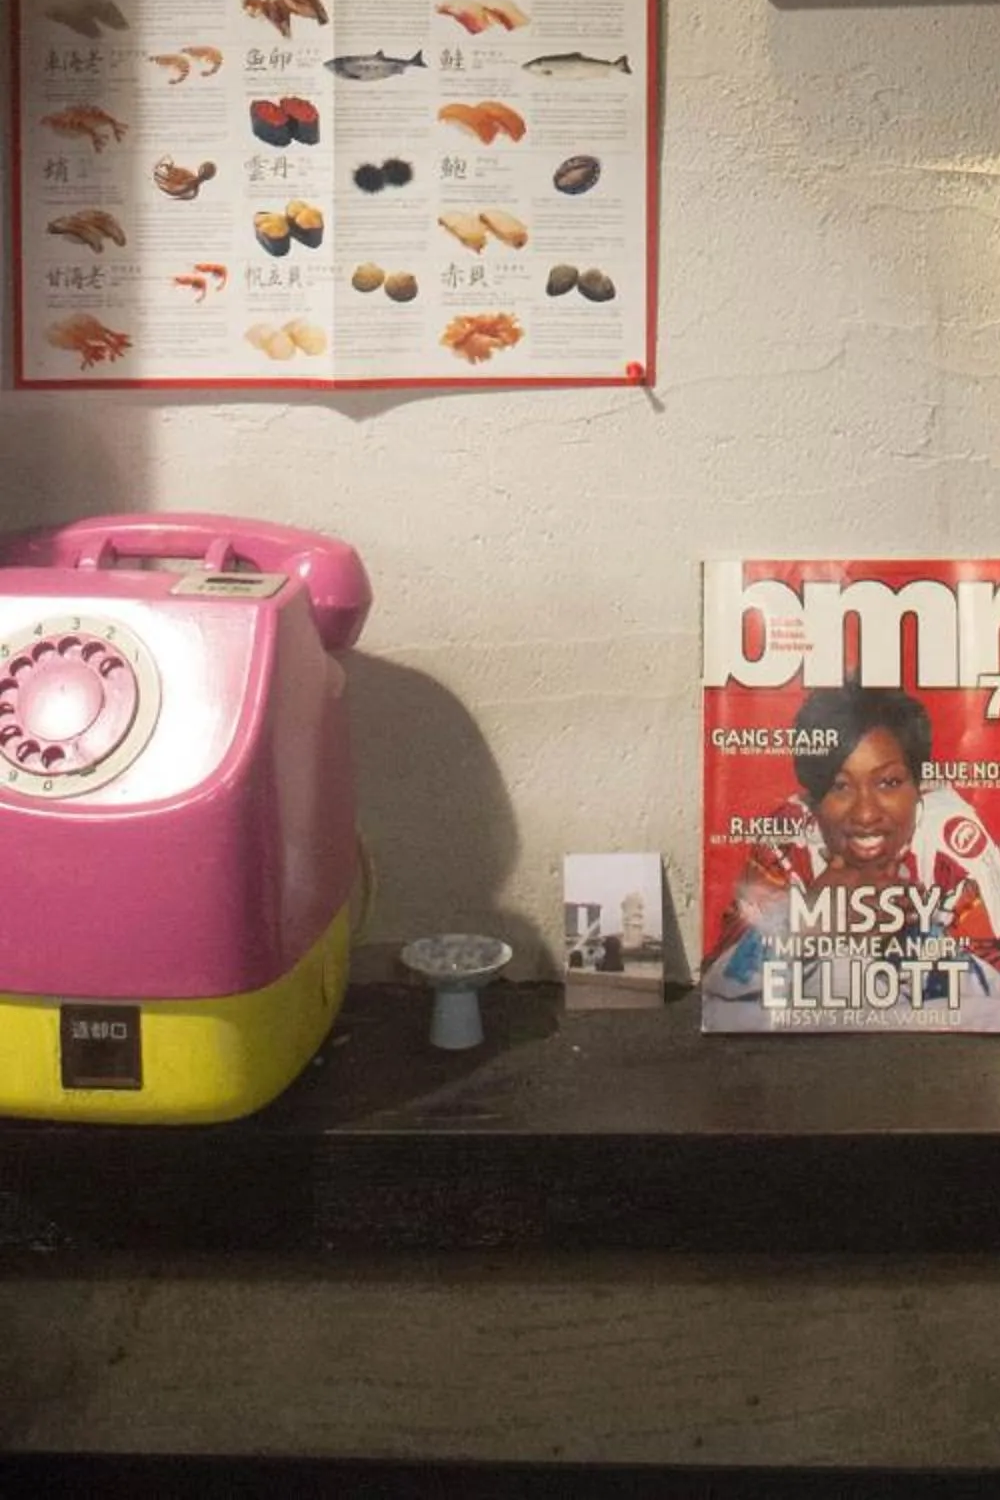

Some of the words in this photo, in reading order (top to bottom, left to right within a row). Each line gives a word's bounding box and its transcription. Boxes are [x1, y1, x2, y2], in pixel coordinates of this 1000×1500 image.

[440, 262, 489, 289] 赤貝
[712, 729, 769, 748] GANG
[773, 729, 839, 747] STARR
[921, 761, 968, 780] BLUE
[730, 816, 802, 835] R.KELLY
[789, 885, 940, 934] MISSY
[761, 937, 970, 960] "MISDEMEANOR"
[761, 961, 969, 1009] ELLIOTT
[771, 1009, 837, 1029] MISSY'S
[843, 1009, 889, 1025] REAL
[892, 1009, 962, 1026] WORLD
